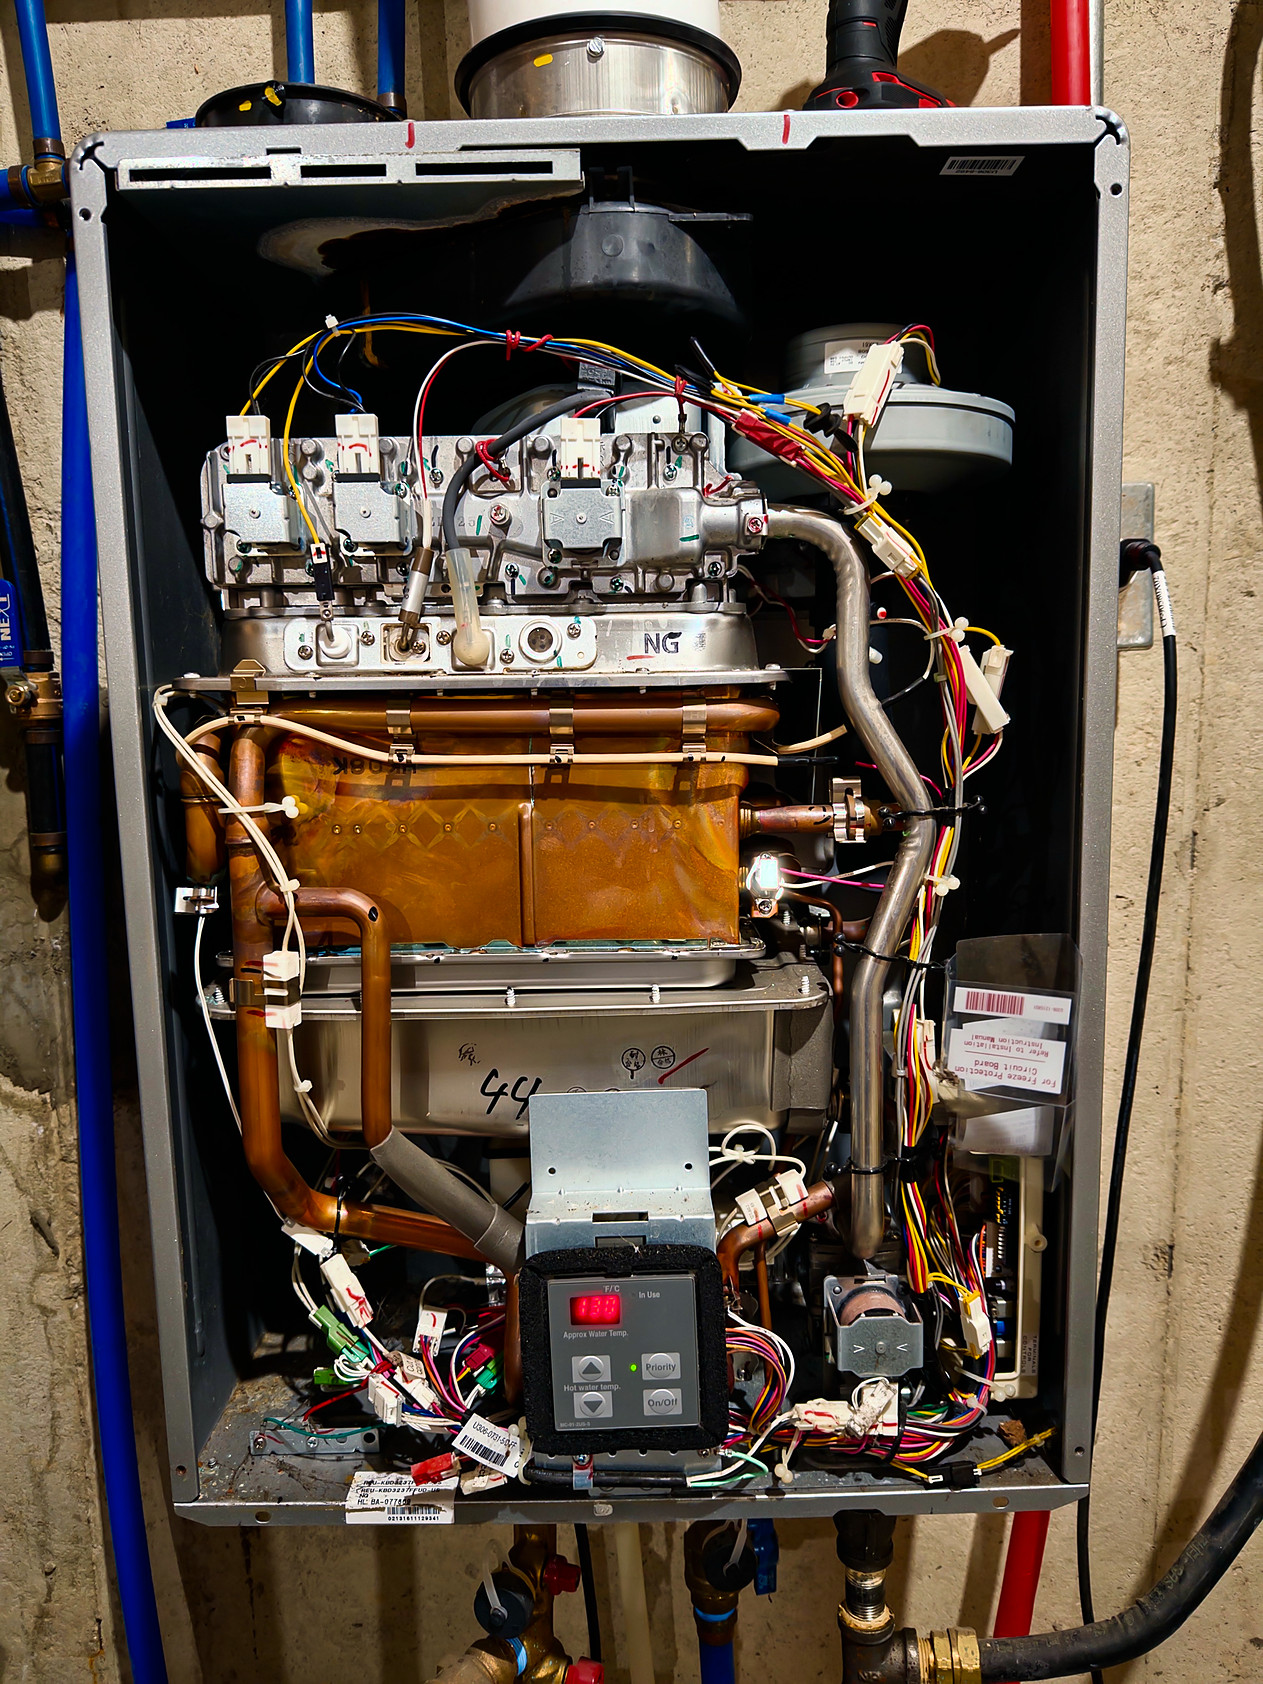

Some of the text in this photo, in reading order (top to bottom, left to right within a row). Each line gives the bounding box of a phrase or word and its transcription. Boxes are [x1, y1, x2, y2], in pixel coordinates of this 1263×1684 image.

[644, 632, 682, 654] NG
[964, 1041, 1012, 1053] Installation
[971, 1034, 1043, 1049] Instruction Manual
[1029, 1049, 1049, 1058] Refer
[974, 1060, 1038, 1076] Circuit Board
[954, 1065, 1056, 1088] For Freeze Protection
[576, 1296, 617, 1318] 130
[563, 1329, 629, 1339] Approx Water Temp.
[645, 1363, 676, 1372] Priority
[600, 1383, 621, 1392] temp.
[647, 1398, 678, 1407] On/Off
